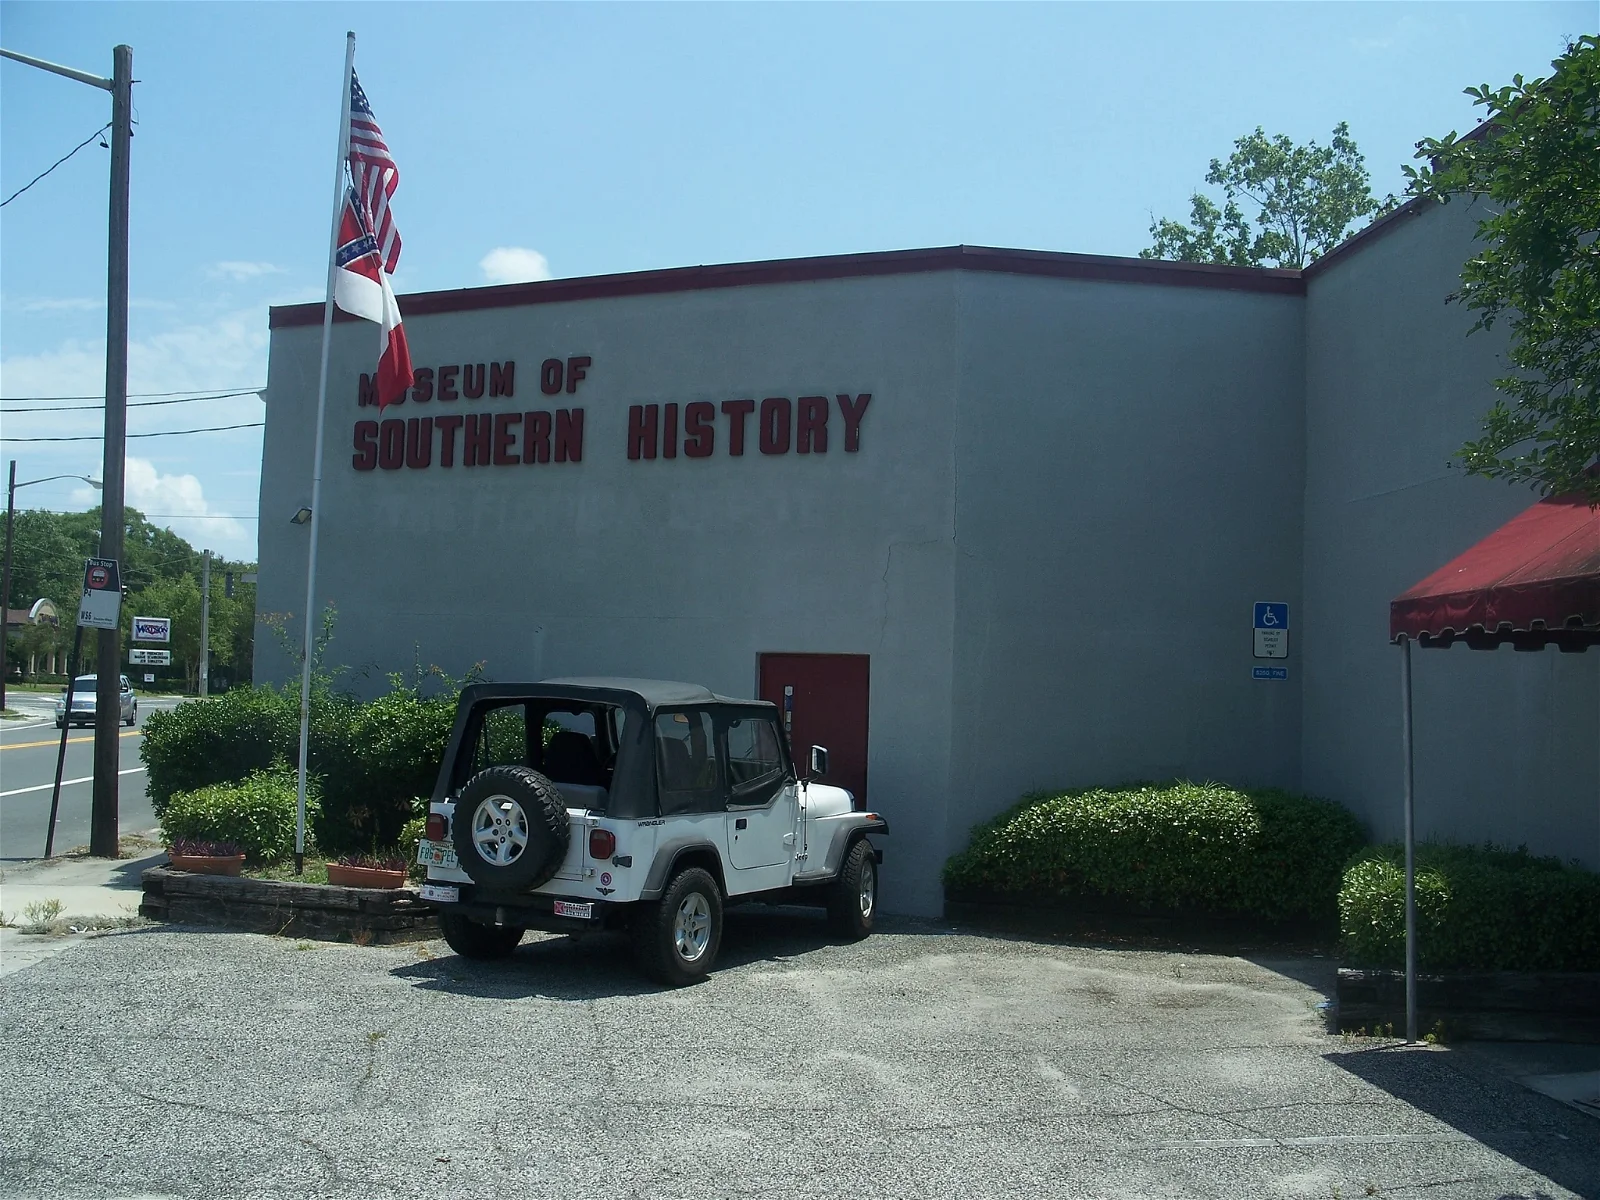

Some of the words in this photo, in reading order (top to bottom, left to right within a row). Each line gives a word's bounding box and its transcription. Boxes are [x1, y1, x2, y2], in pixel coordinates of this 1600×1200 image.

[358, 360, 515, 407] MSEUM
[540, 356, 592, 395] OF
[352, 408, 584, 471] SOUTHERN
[627, 393, 872, 460] HISTORY
[83, 589, 92, 597] P4
[637, 820, 666, 828] WRANGLER
[794, 850, 808, 861] Jeep
